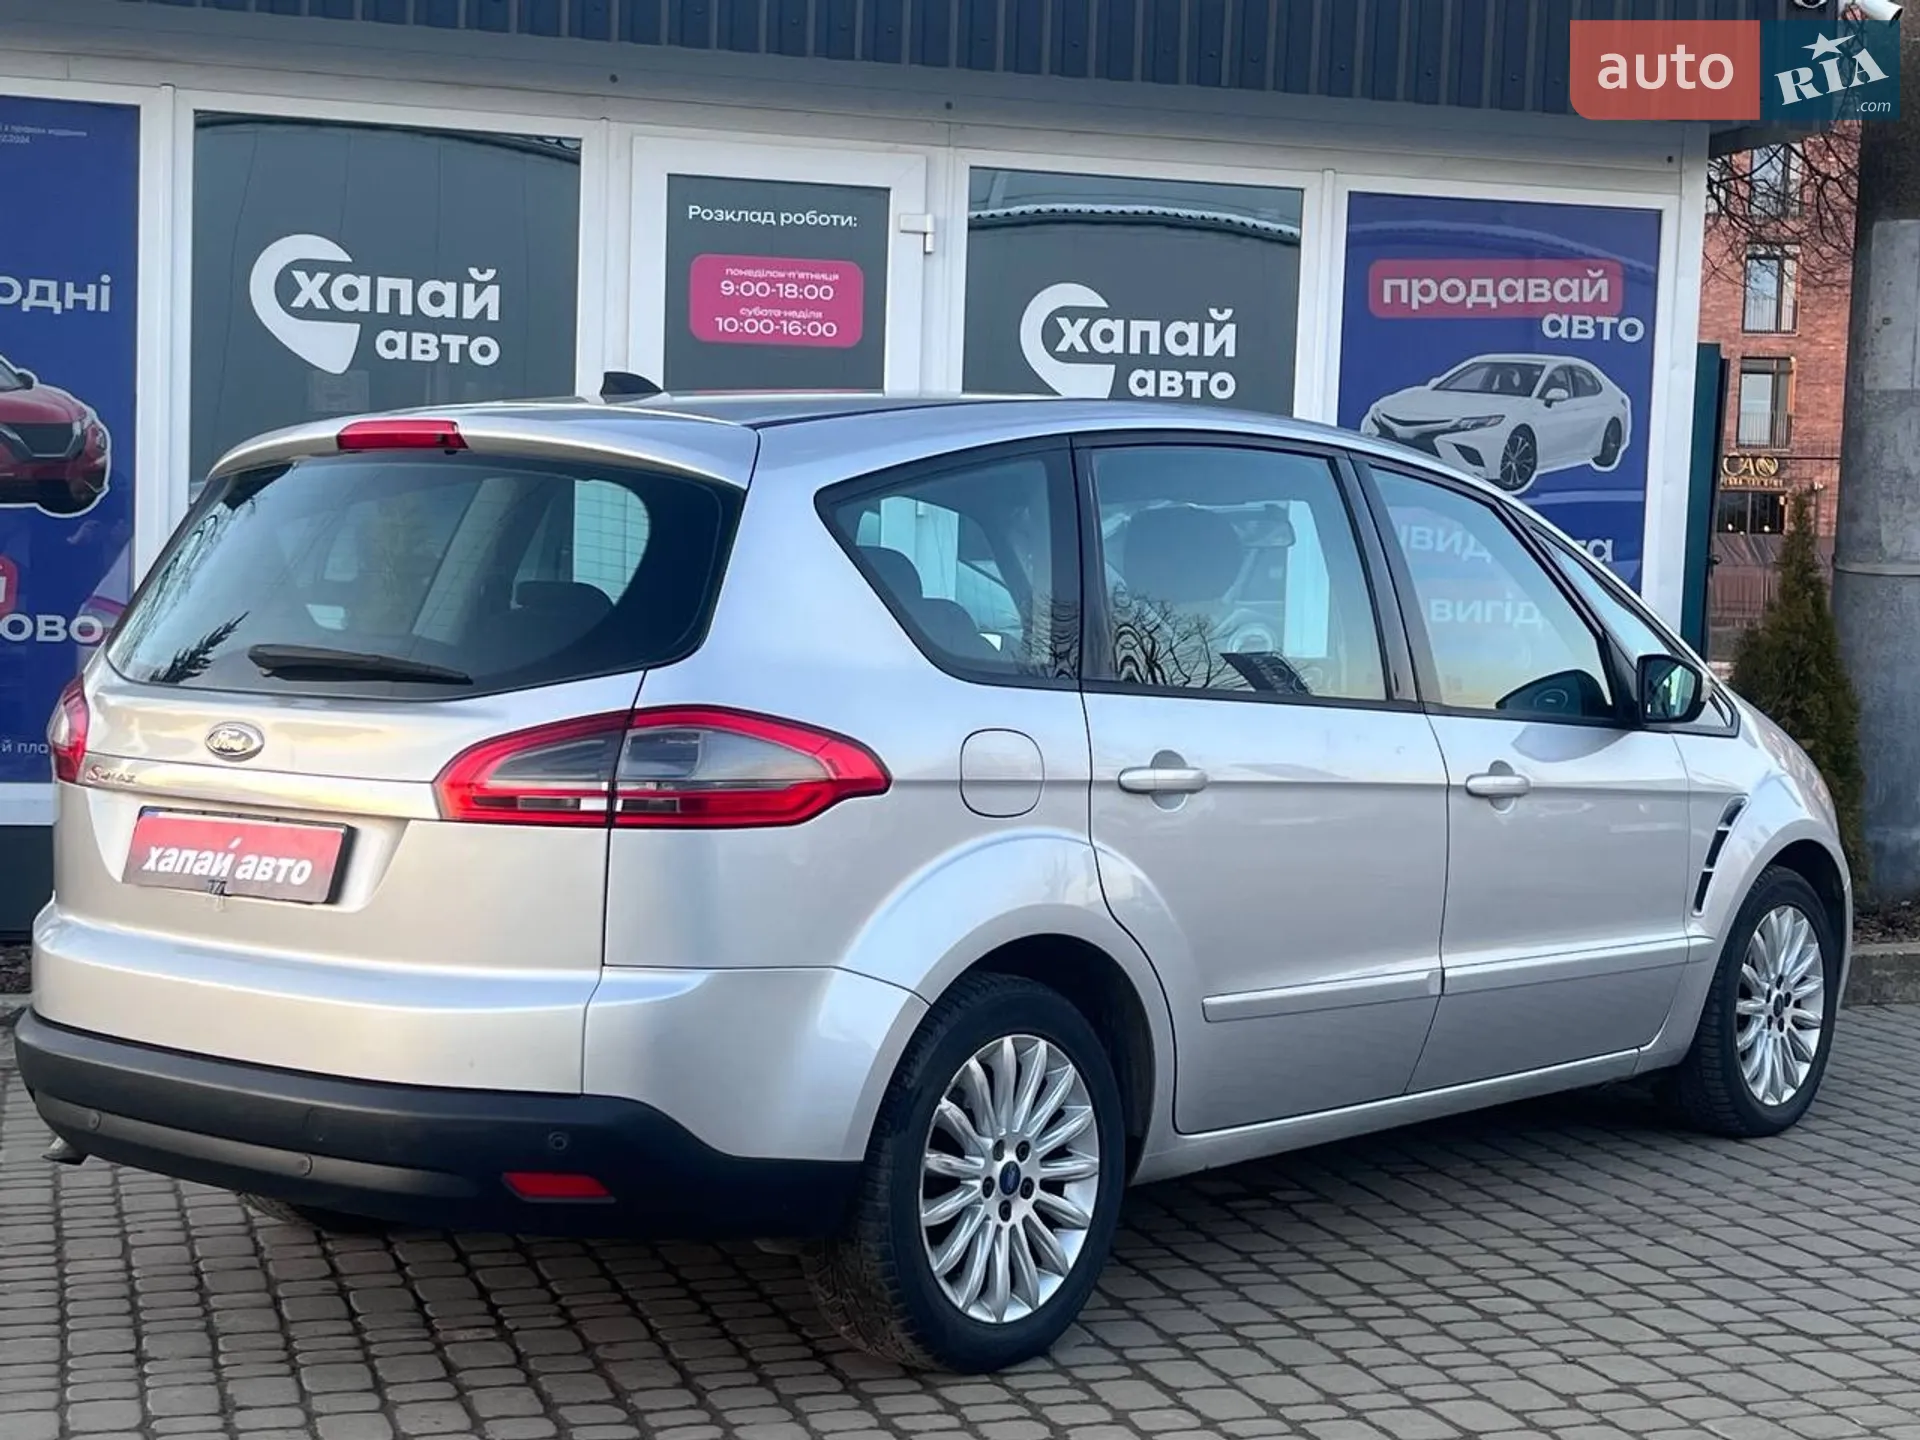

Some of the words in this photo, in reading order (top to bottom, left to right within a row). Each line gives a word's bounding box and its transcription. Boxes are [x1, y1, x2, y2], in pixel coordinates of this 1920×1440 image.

[688, 204, 776, 226] Розклад
[780, 210, 858, 227] роботи:
[290, 266, 500, 321] хапай
[720, 280, 834, 301] 9:00-18:00
[1383, 269, 1609, 310] продавай
[715, 316, 838, 337] 10:00-16:00
[1054, 307, 1237, 357] хапай
[1541, 313, 1645, 343] авто
[375, 328, 500, 366] авто
[1128, 368, 1236, 399] авто
[1400, 525, 1492, 563] вид
[142, 838, 243, 877] хапай
[235, 853, 313, 885] авто
